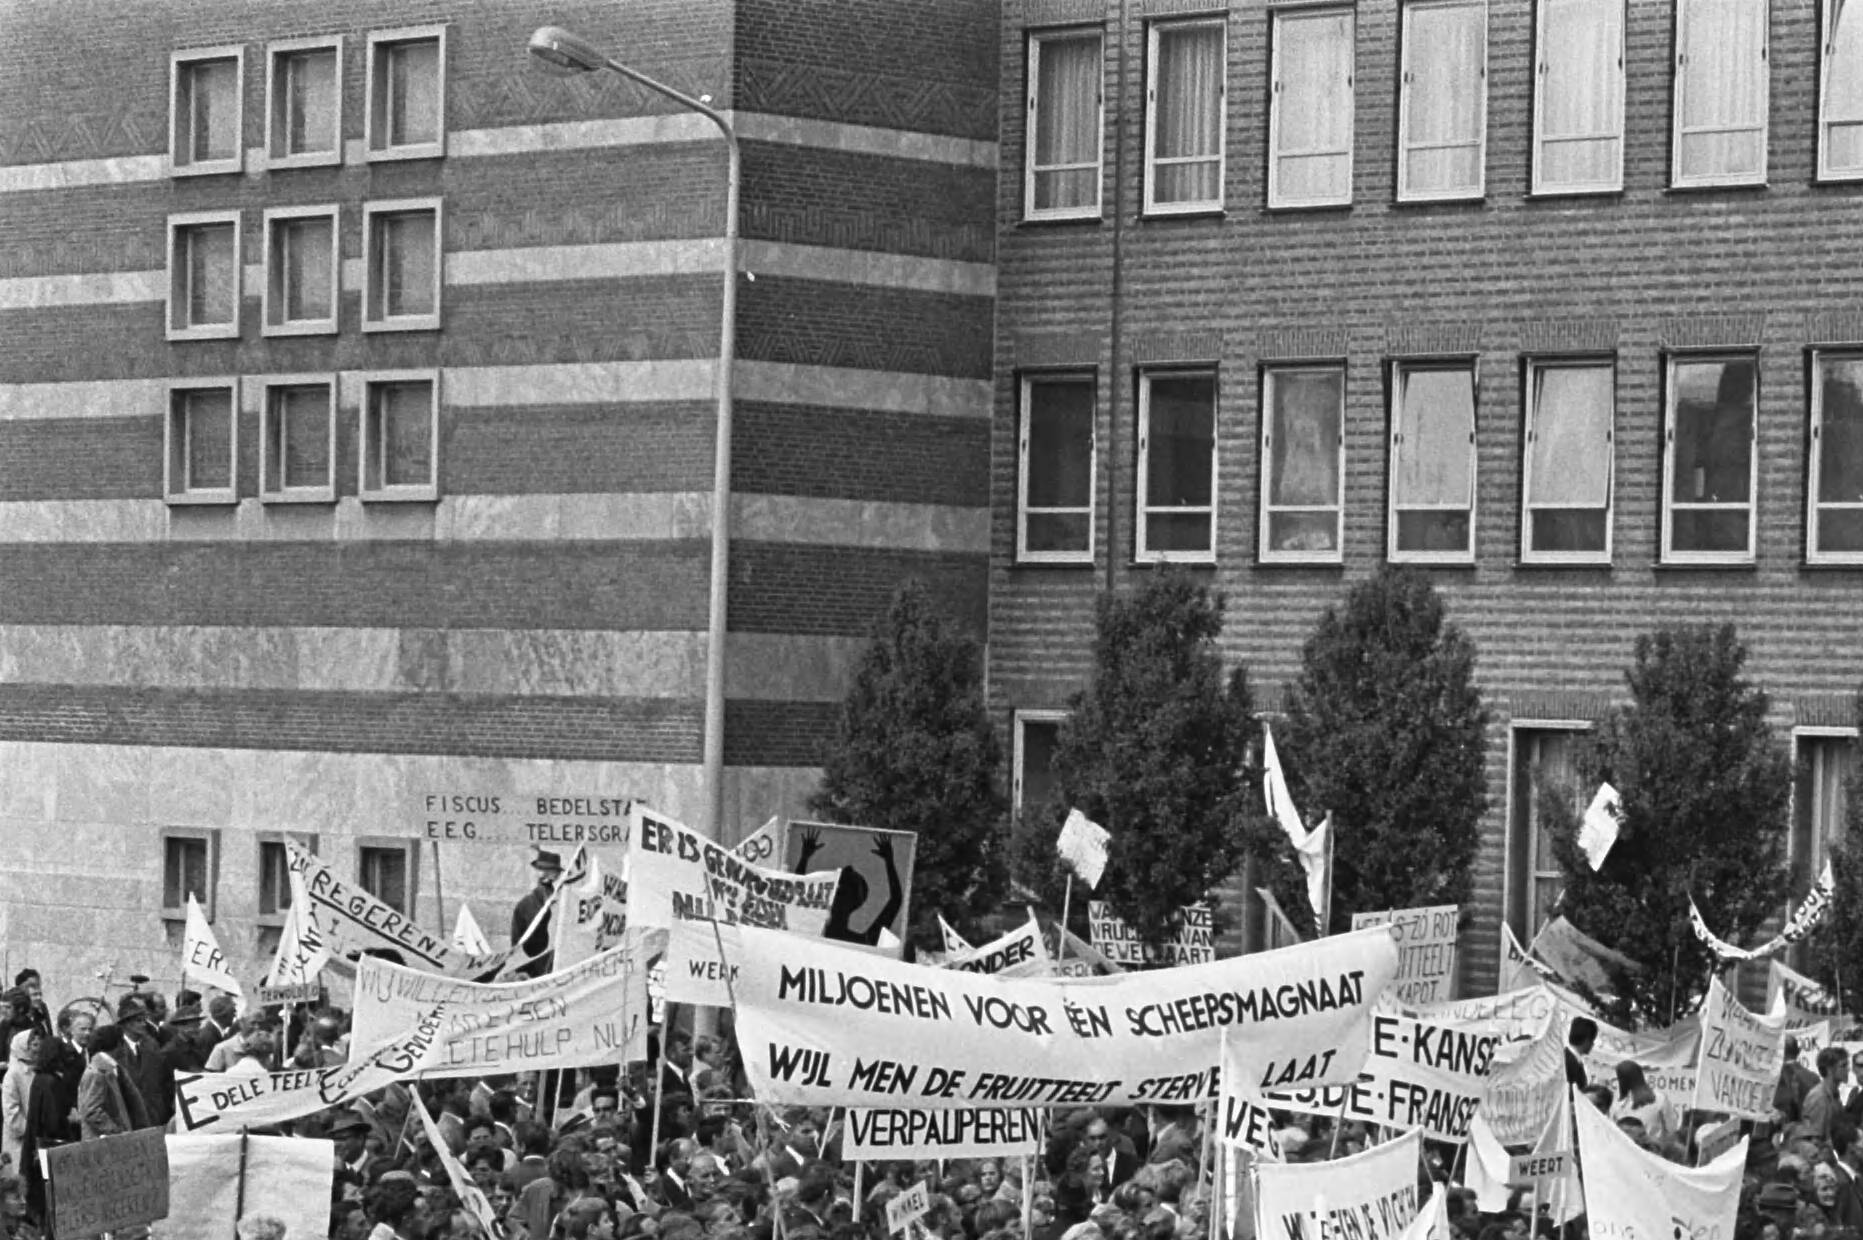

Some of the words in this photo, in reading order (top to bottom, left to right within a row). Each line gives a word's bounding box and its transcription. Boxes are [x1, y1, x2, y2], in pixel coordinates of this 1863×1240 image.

[642, 816, 674, 855] ER
[677, 831, 701, 863] IS
[1433, 910, 1458, 939] ROT
[778, 964, 952, 1021] MILJOENEN
[963, 993, 1054, 1036] VOOR
[1126, 970, 1365, 1037] SCHEEPSMAGNAAT
[769, 1042, 832, 1088] WIJL
[848, 1056, 919, 1095] MEN
[921, 1067, 966, 1099] DE
[967, 1072, 1123, 1103] FRUITTEELT
[1128, 1065, 1222, 1101] STERVE
[1260, 1048, 1338, 1089] LAAT
[849, 1106, 1040, 1147] VERPAUPEREN
